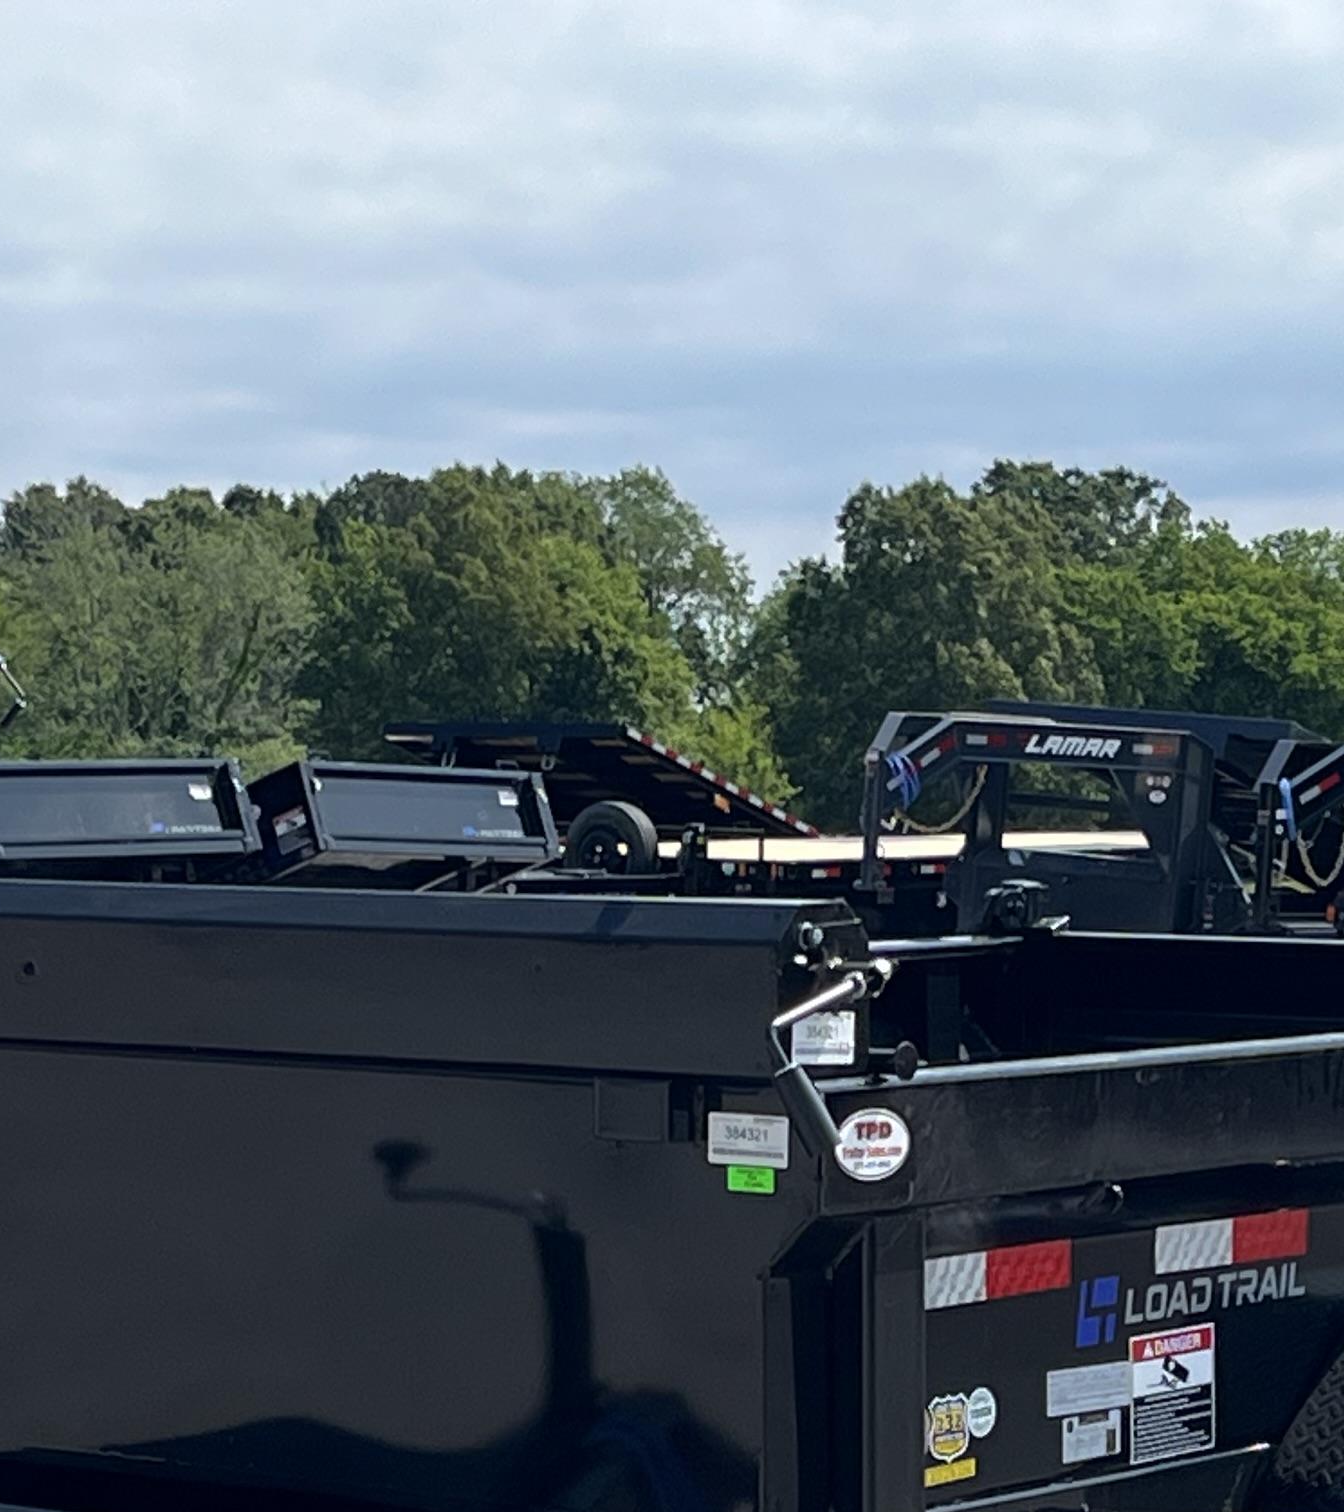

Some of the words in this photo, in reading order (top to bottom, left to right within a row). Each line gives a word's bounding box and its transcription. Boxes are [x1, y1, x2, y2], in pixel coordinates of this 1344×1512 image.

[1024, 733, 1122, 759] LAMAR
[854, 1121, 893, 1141] TPD
[1124, 1276, 1212, 1325] LOAD
[1216, 1262, 1307, 1310] TRAIL
